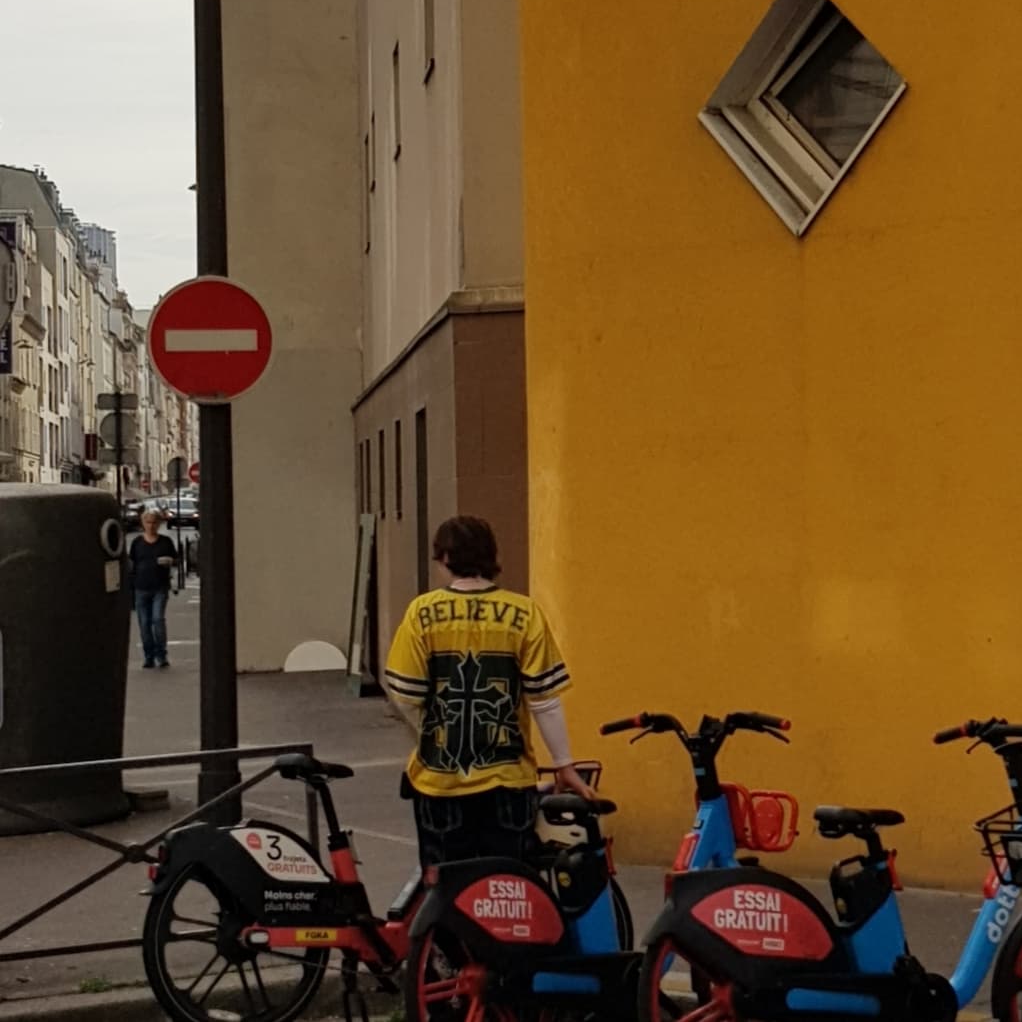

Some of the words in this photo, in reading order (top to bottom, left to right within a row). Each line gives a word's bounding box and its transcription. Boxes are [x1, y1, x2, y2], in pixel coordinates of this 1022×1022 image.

[418, 599, 529, 630] BELIEVE
[266, 835, 282, 861] 3
[267, 862, 317, 875] GRATUITS
[264, 890, 293, 901] Moins
[488, 880, 526, 900] ESSAI
[733, 889, 780, 911] ESSAI
